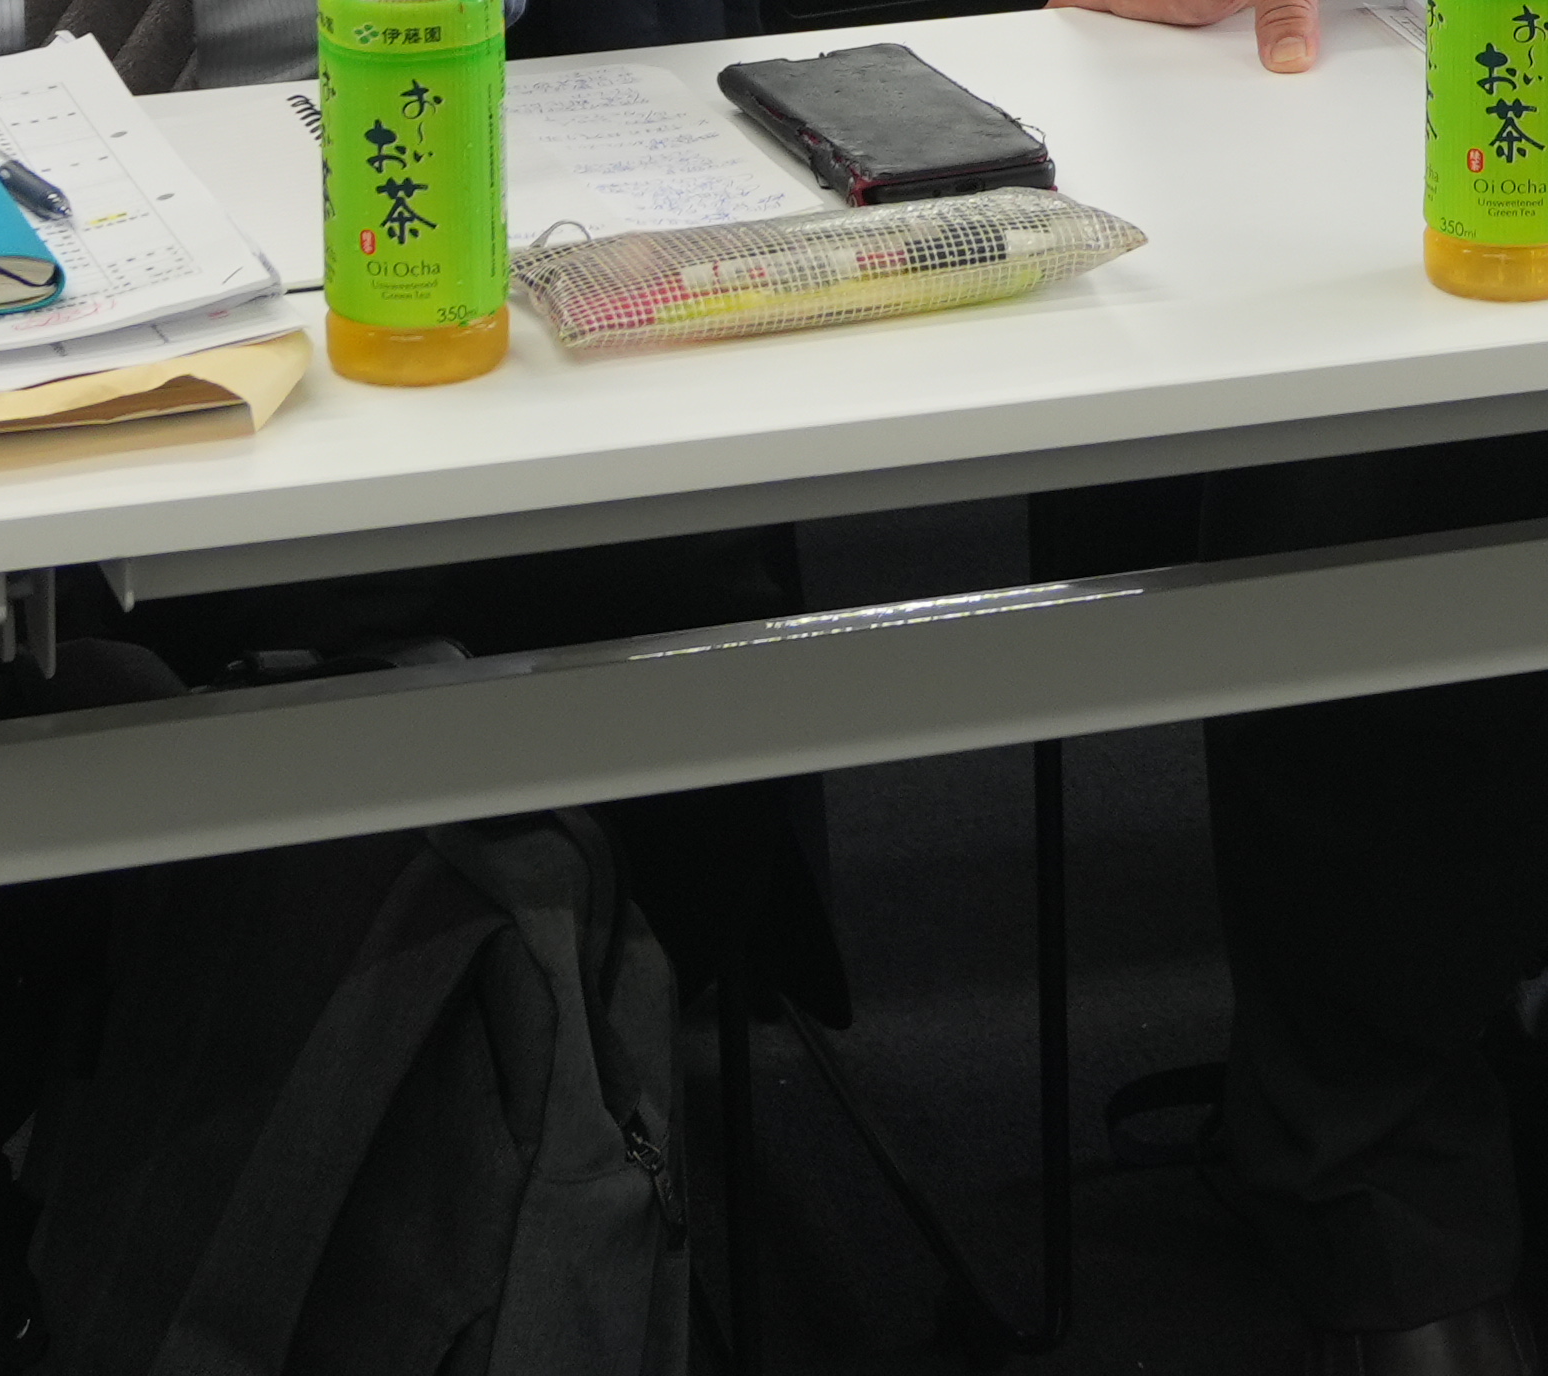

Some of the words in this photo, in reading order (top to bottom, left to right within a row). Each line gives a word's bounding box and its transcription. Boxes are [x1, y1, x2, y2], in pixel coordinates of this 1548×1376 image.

[382, 26, 442, 45] 伊藤園
[1475, 42, 1546, 163] お茶
[364, 118, 438, 245] お茶
[1473, 178, 1495, 194] Oi
[1500, 178, 1547, 195] Ocha
[1477, 198, 1544, 207] Unsweetened
[1487, 208, 1518, 217] Green
[1519, 208, 1536, 217] Tea
[1439, 216, 1477, 238] 350ml
[366, 260, 389, 277] Oi
[393, 260, 441, 277] Ocha
